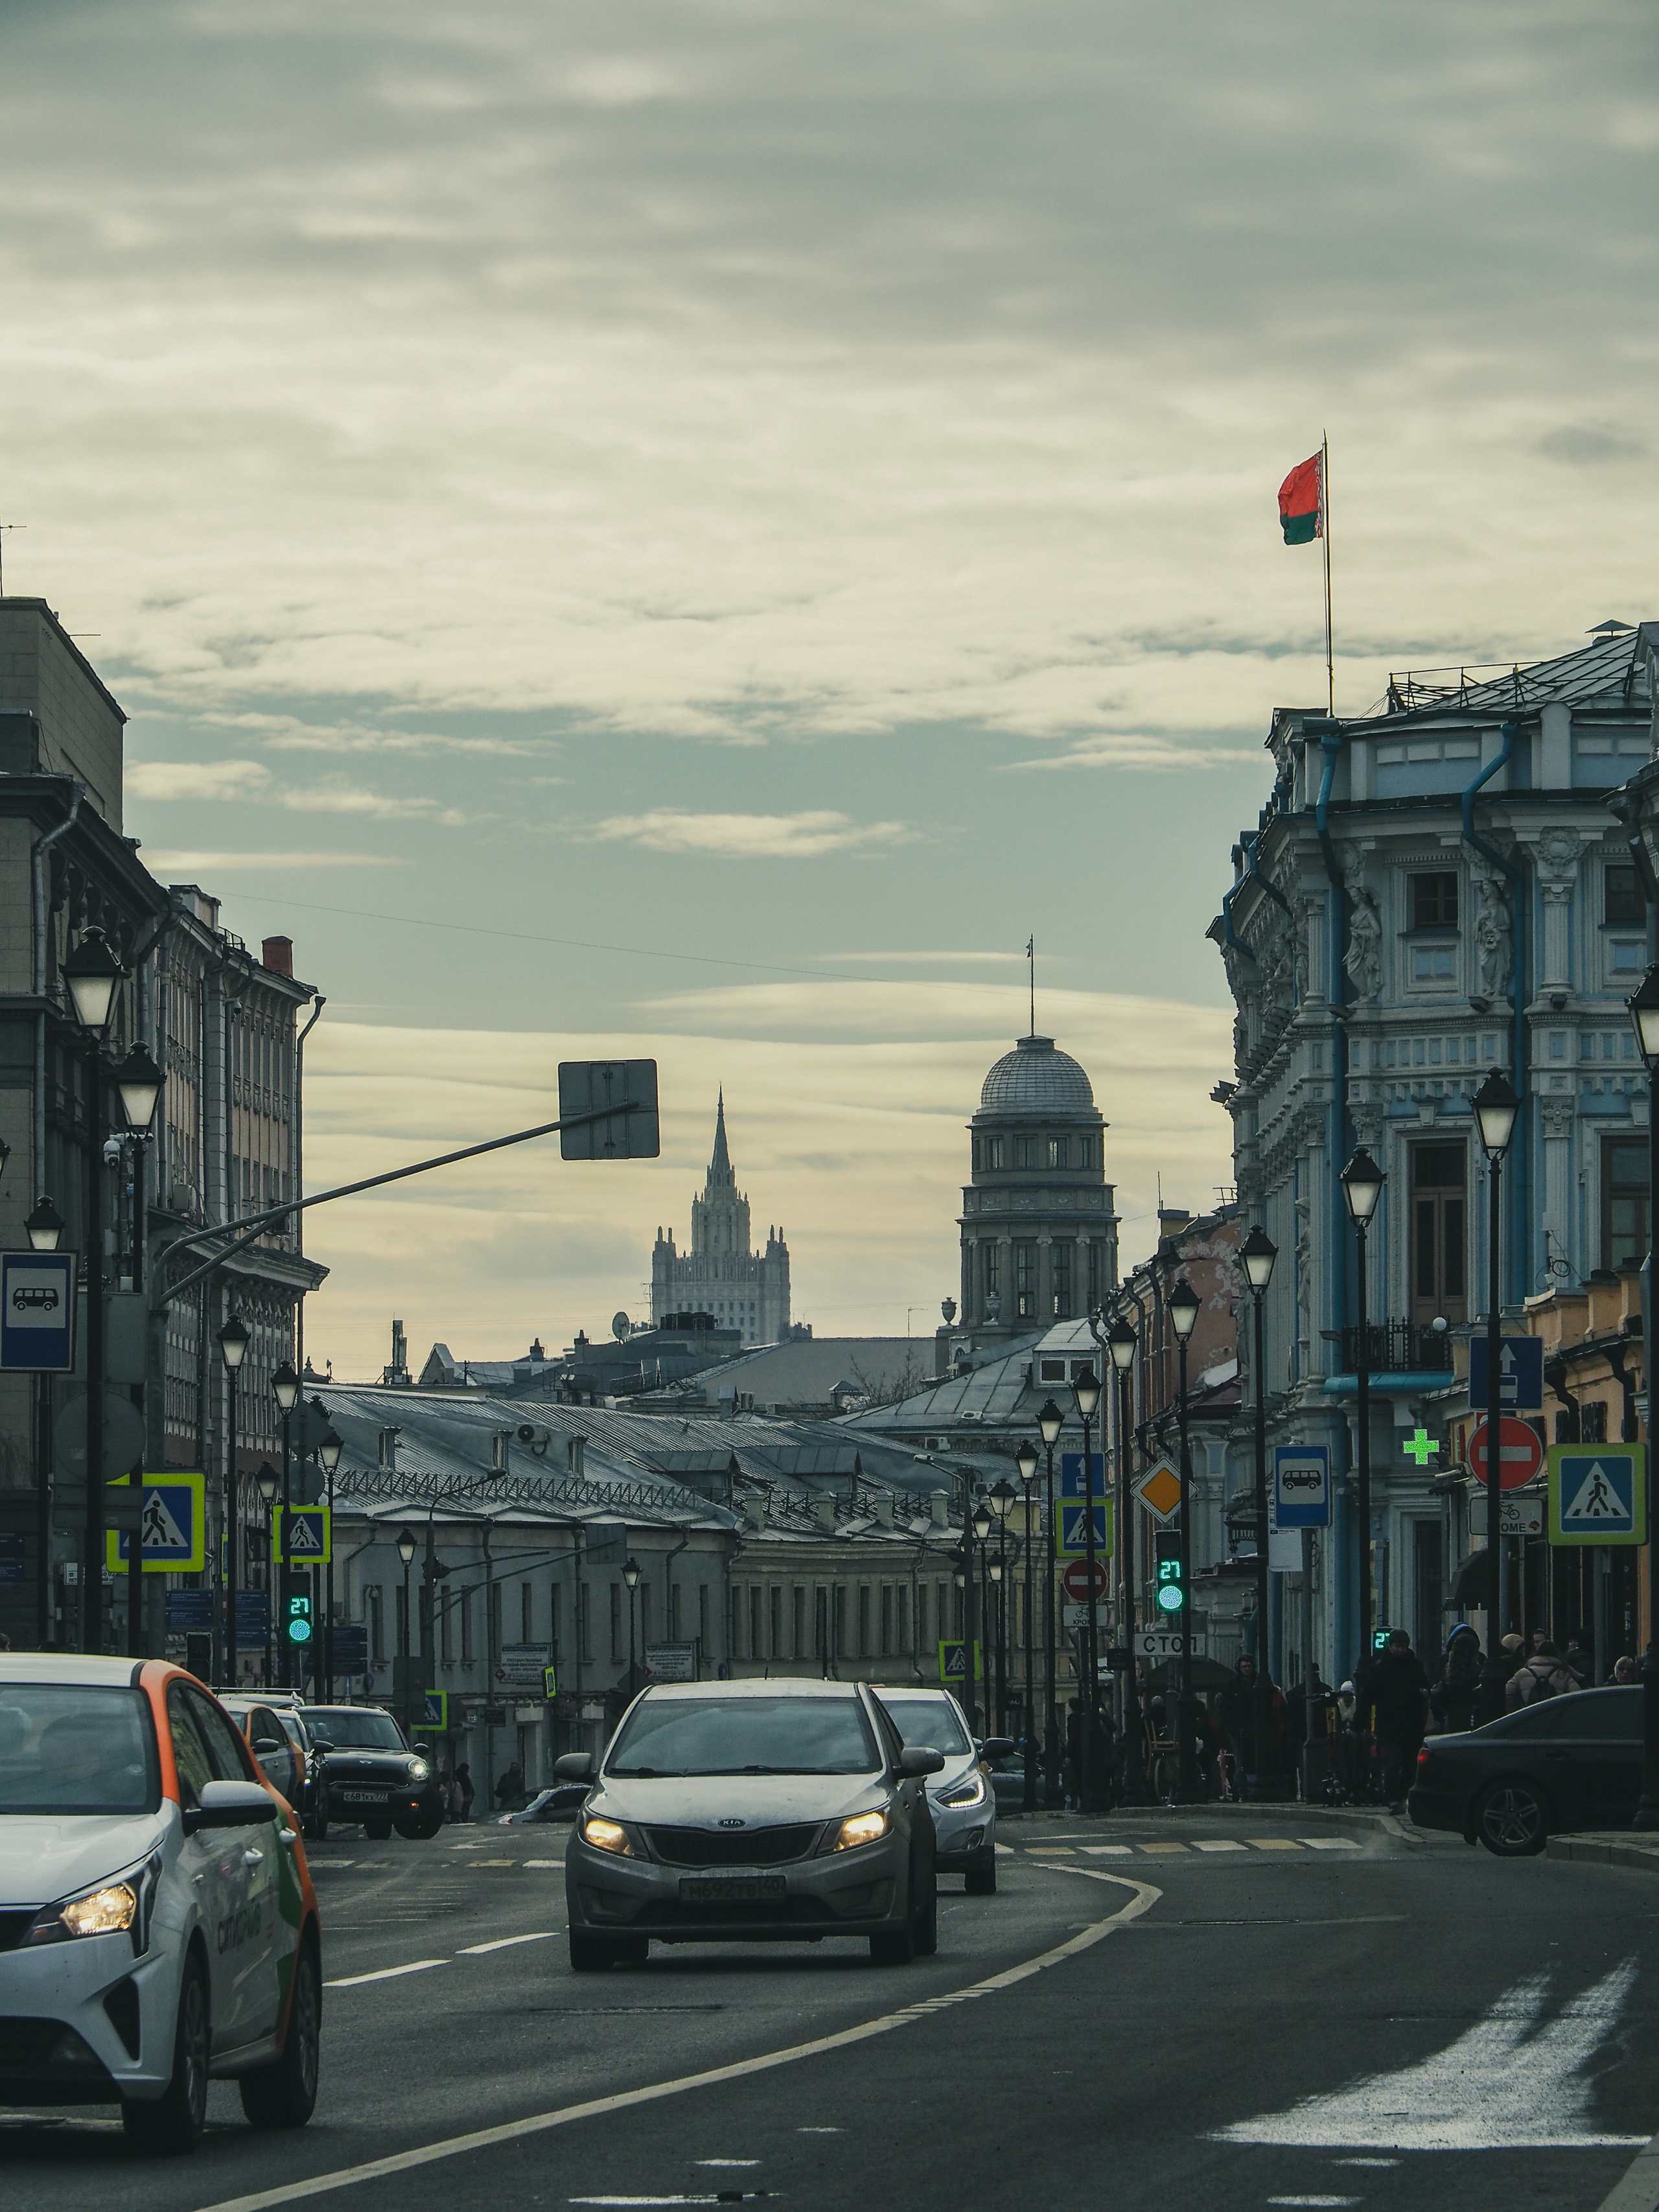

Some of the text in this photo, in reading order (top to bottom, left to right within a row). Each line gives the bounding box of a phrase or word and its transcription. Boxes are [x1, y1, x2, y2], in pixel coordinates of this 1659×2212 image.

[1501, 1522, 1526, 1532] ОМЕ
[1160, 1561, 1181, 1579] 27
[290, 1598, 309, 1614] 27
